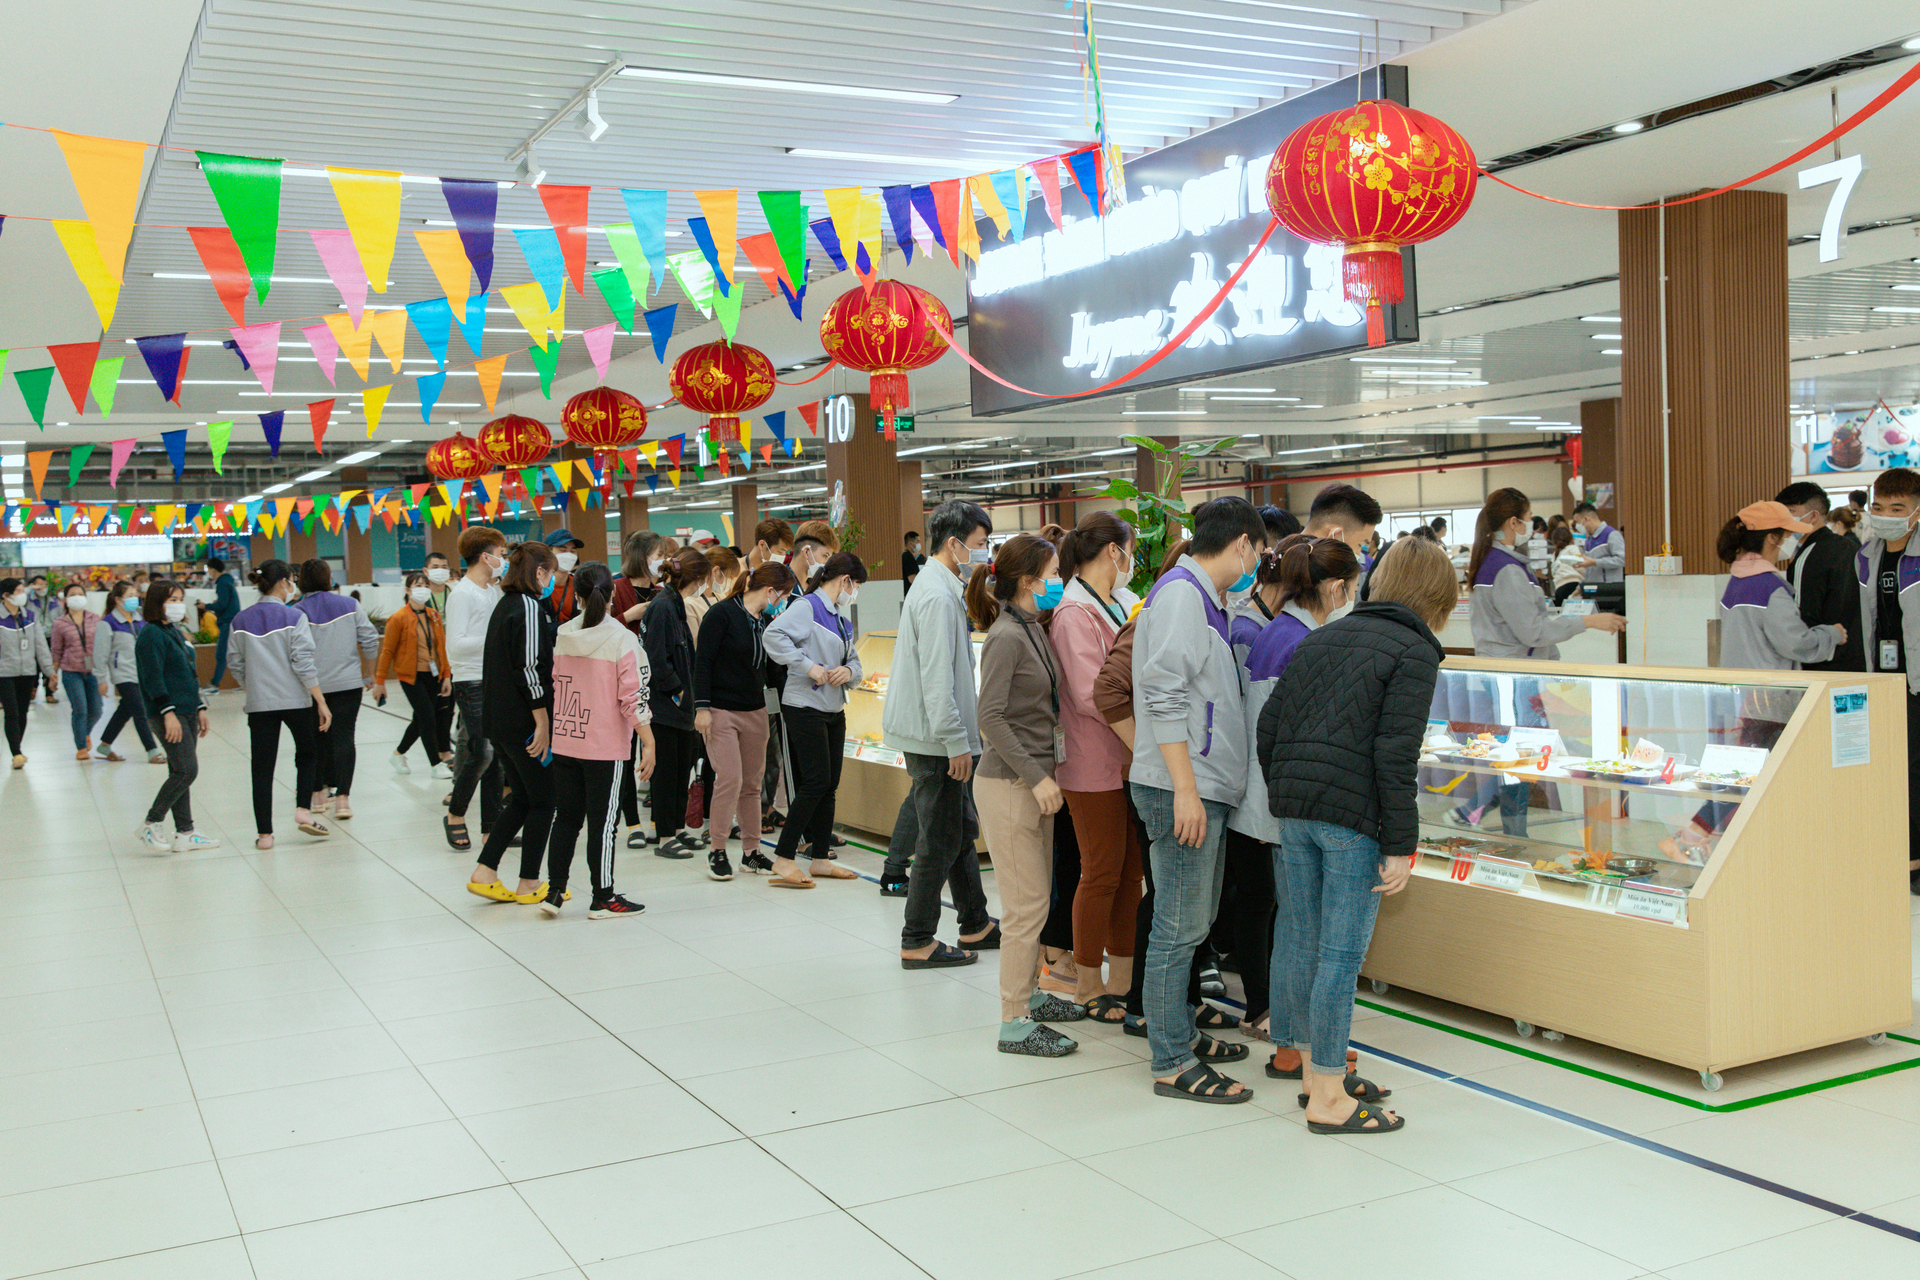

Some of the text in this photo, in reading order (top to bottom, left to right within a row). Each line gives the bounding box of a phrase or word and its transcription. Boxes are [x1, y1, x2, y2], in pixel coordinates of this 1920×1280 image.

[1797, 153, 1863, 264] 7
[825, 394, 851, 444] 10
[1795, 414, 1818, 444] 11
[554, 674, 591, 740] LA
[1536, 745, 1552, 771] 3
[1660, 757, 1676, 785] 4
[1450, 852, 1473, 882] 10
